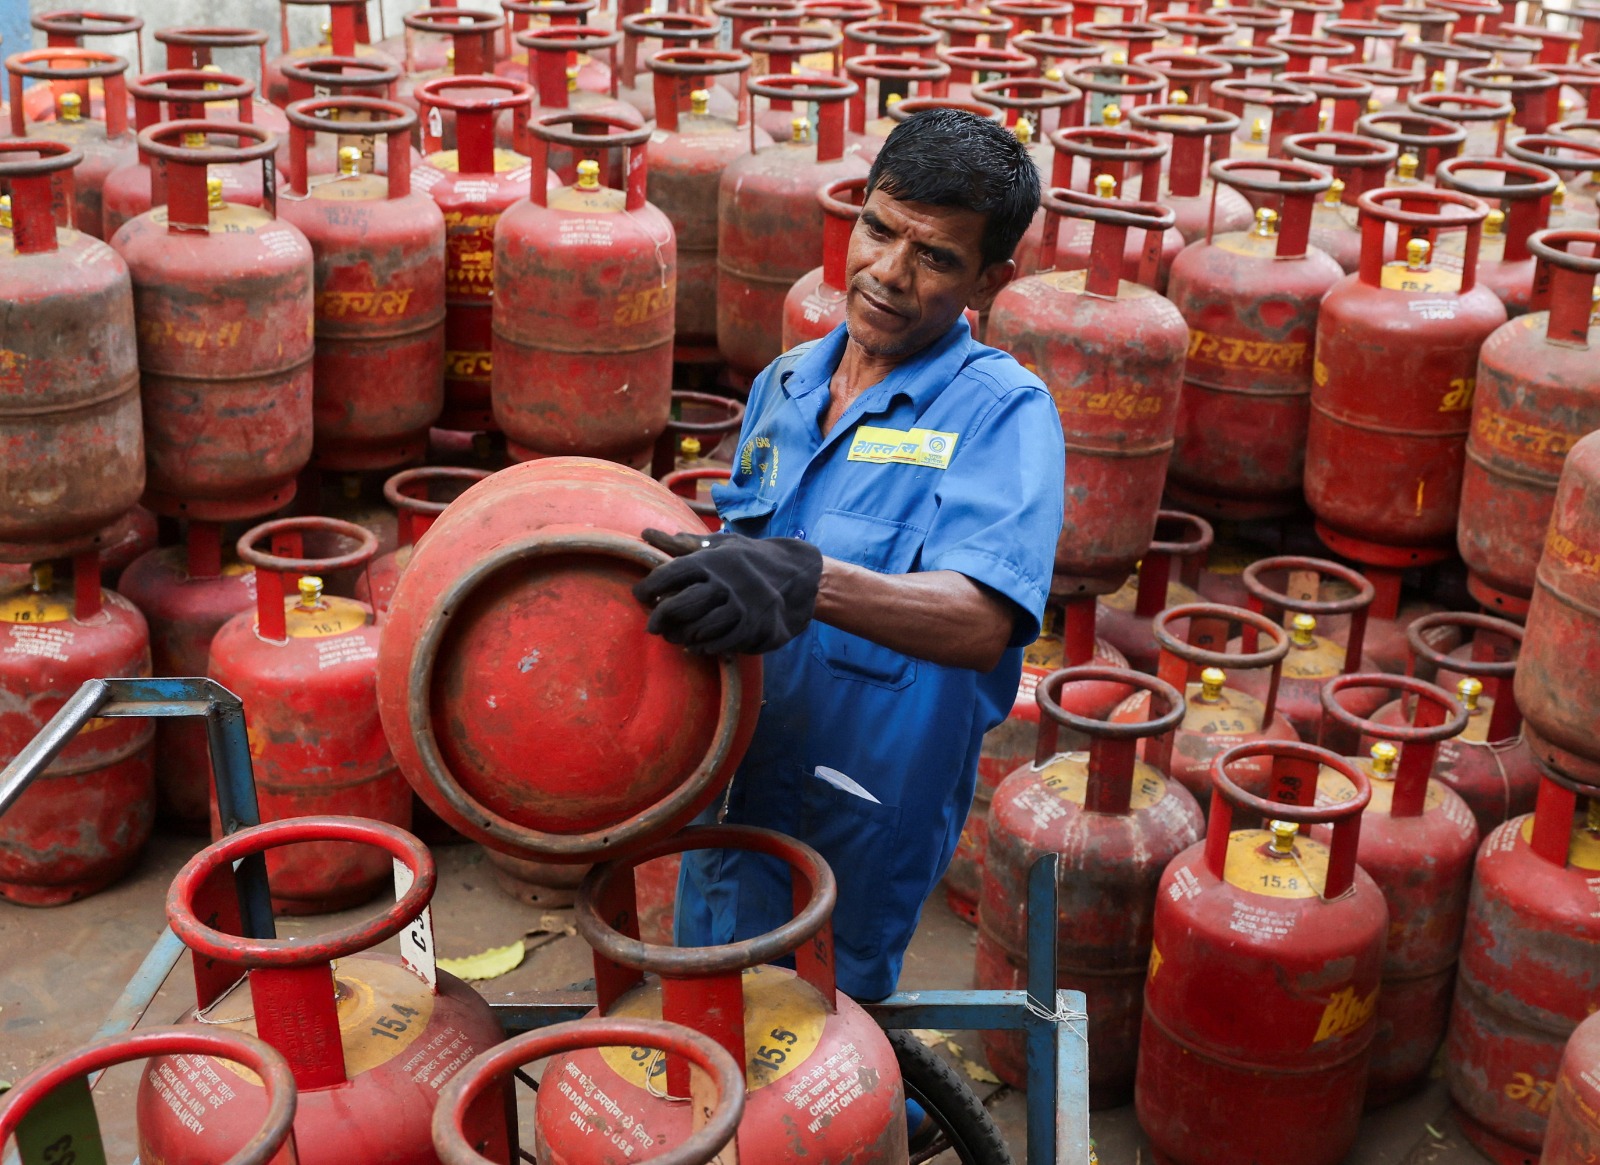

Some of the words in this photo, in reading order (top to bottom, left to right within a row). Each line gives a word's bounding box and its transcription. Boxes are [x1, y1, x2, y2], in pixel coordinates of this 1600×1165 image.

[1259, 874, 1299, 891] 15.8
[370, 1003, 420, 1040] 15.4
[430, 1058, 462, 1089] SWITCH
[460, 1045, 475, 1060] OFF
[752, 1028, 798, 1071] 15.5
[159, 1063, 179, 1087] CHECK
[173, 1081, 191, 1103] SEAL
[187, 1098, 206, 1117] AND
[161, 1087, 174, 1103] ON
[168, 1095, 205, 1135] DELIVERY
[809, 1088, 839, 1117] CHECK
[835, 1075, 856, 1095] SEAL
[839, 1093, 853, 1108] ON
[569, 1111, 594, 1136] ONLY
[593, 1089, 624, 1119] उपयोग
[632, 1123, 654, 1149] लिए
[611, 1133, 635, 1157] USE
